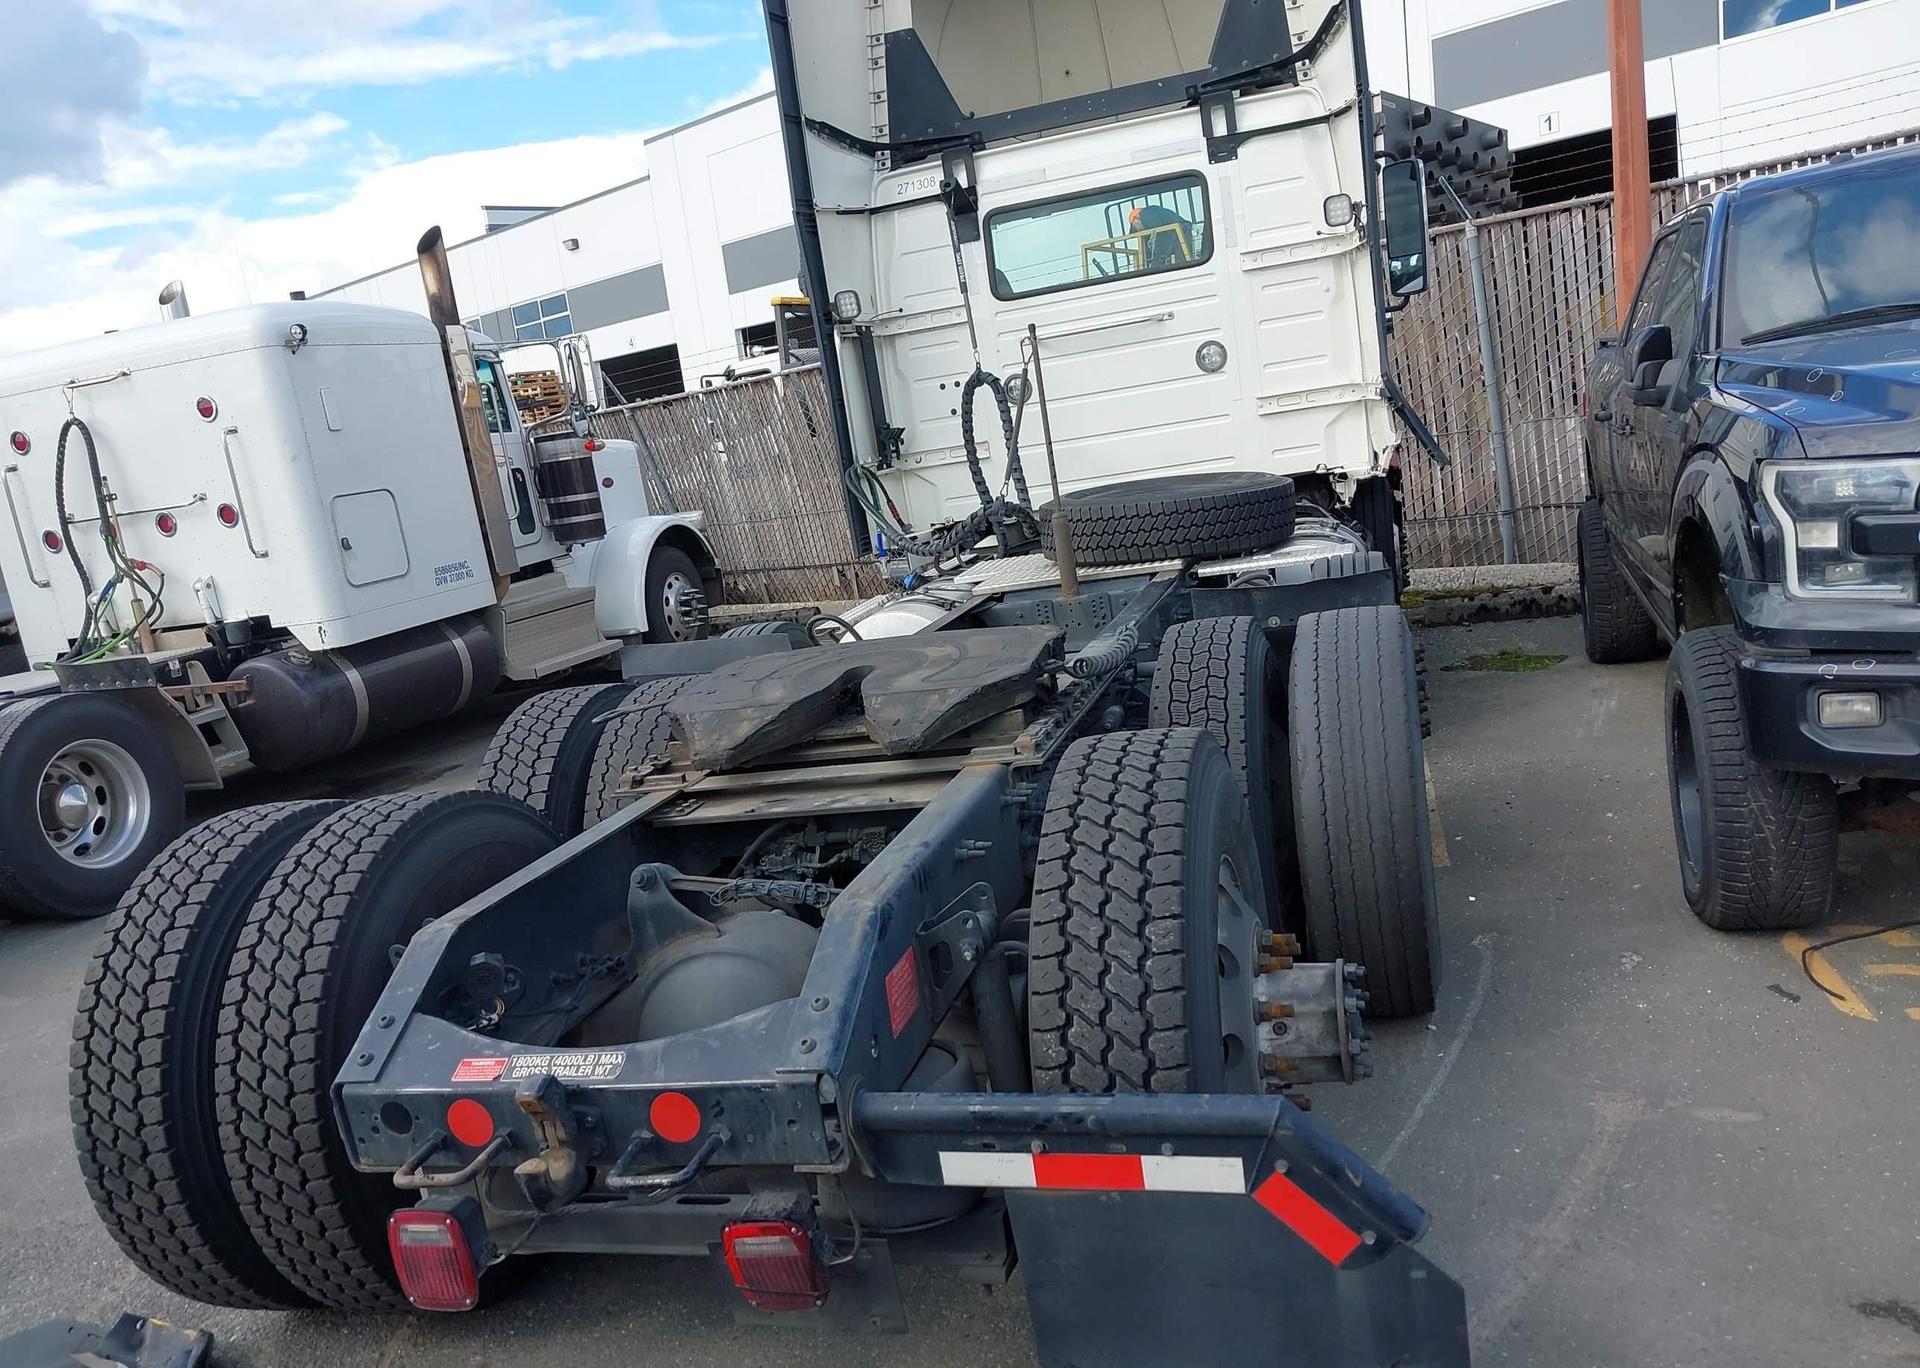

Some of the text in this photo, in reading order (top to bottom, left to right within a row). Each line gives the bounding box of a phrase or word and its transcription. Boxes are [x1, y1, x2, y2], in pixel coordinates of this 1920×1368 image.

[1544, 115, 1552, 132] 1
[896, 175, 936, 196] 271308
[434, 575, 449, 587] GVW
[465, 569, 474, 580] KG
[511, 1053, 623, 1067] 1800KG (4000LB) MAX
[550, 1065, 593, 1077] TRAILER
[594, 1064, 613, 1076] WT
